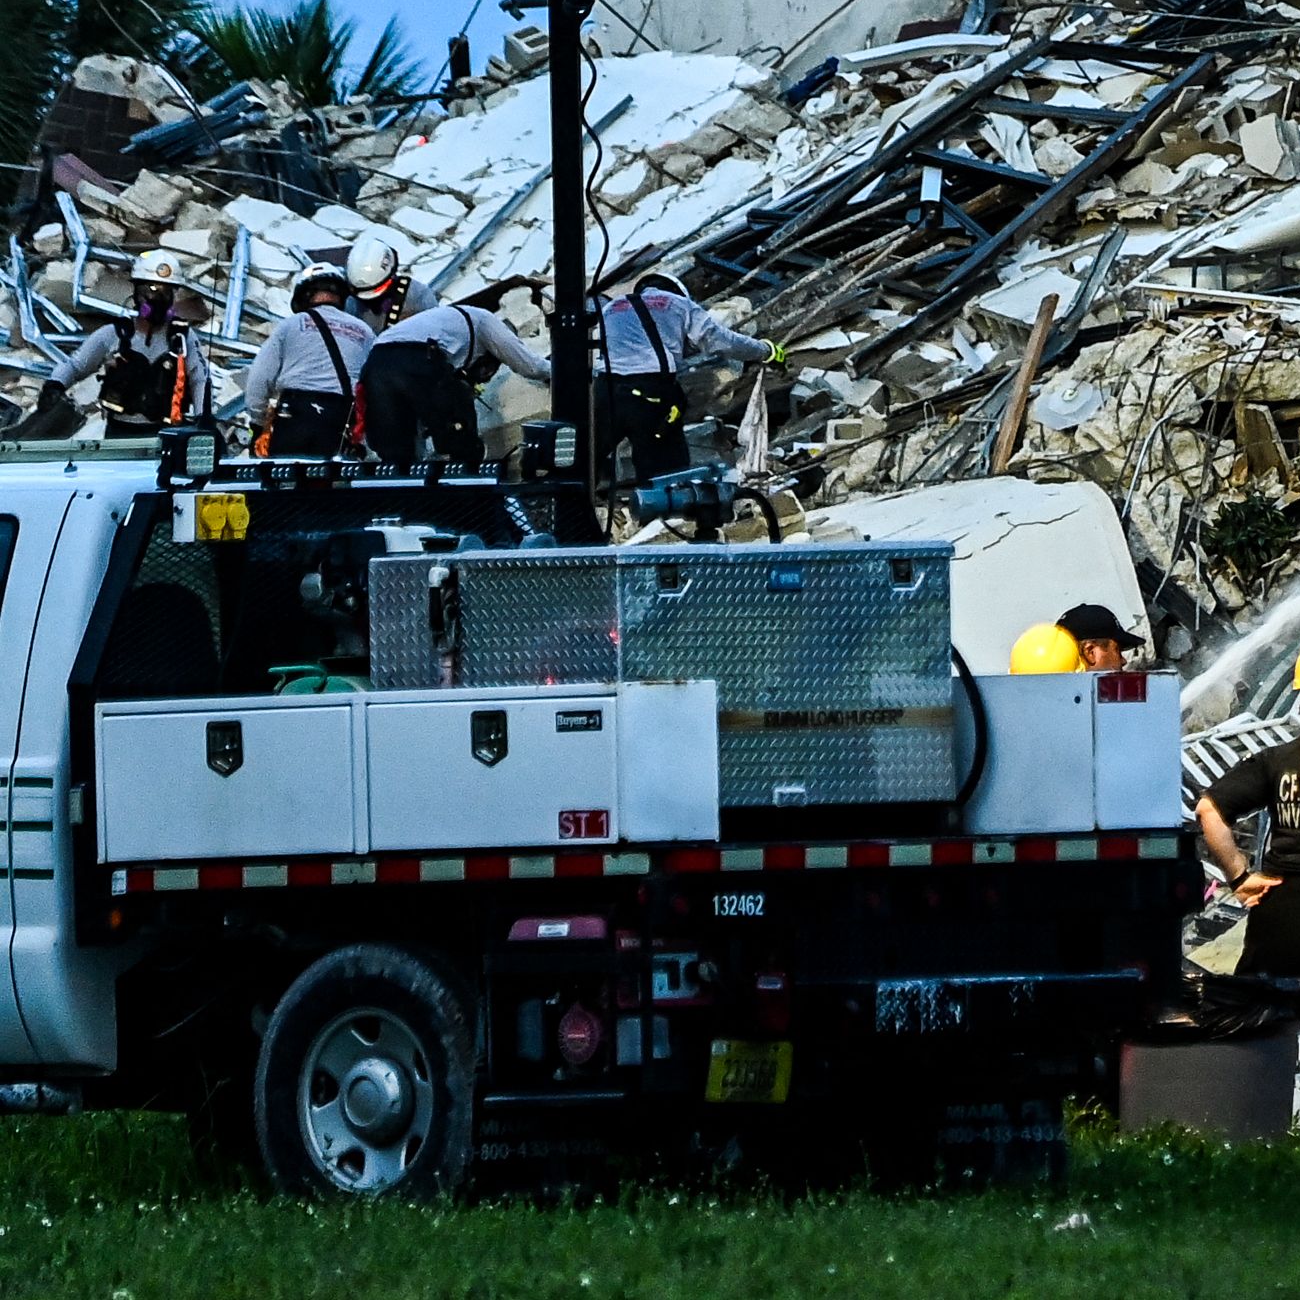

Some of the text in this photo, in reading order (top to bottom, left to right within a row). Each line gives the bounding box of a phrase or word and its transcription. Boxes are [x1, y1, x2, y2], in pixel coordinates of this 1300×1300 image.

[560, 812, 608, 838] ST 1
[712, 893, 765, 918] 132462
